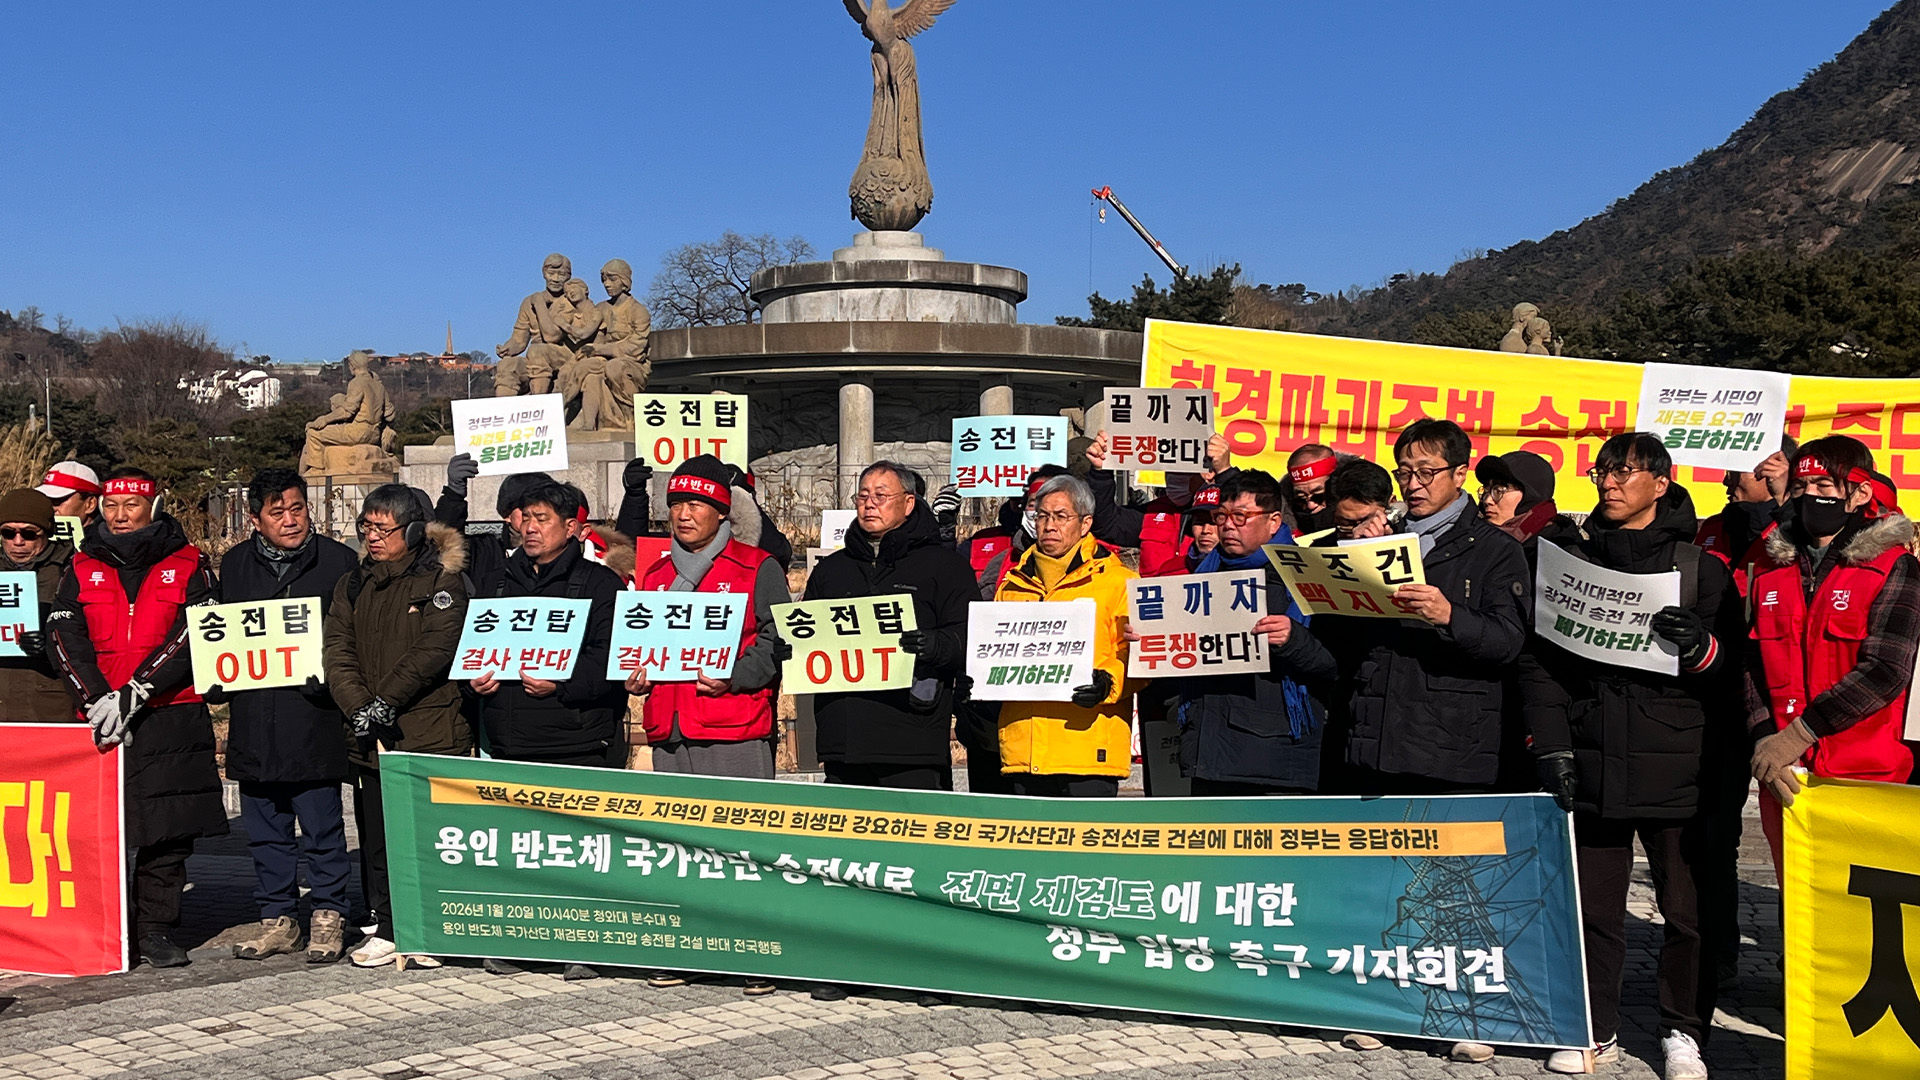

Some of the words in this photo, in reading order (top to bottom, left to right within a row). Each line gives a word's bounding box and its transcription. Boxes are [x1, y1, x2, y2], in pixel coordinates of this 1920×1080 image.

[1659, 388, 1708, 404] 정부는
[1711, 390, 1763, 406] 시민의
[468, 416, 504, 431] 정부는
[508, 409, 545, 424] 시민의
[643, 399, 739, 428] 송전탑
[1654, 410, 1707, 426] 재검토
[1707, 411, 1763, 428] 요구에
[469, 431, 507, 447] 재검토
[509, 425, 549, 442] 요구에
[958, 426, 1056, 452] 송전탑
[1663, 428, 1766, 451] 응답하라!
[479, 439, 554, 464] 응답하라!
[955, 464, 1038, 488] 결사반
[1274, 546, 1415, 585] 무조건
[1560, 573, 1644, 606] 구시대적인
[623, 602, 734, 630] 송전탑
[1544, 585, 1587, 615] 장거리
[1589, 606, 1626, 625] 송전
[1628, 612, 1654, 627] 계
[199, 603, 312, 642] 송전탑
[473, 608, 576, 633] 송전탑
[785, 601, 904, 639] 송전탑
[995, 620, 1068, 637] 구시대적인
[1553, 614, 1654, 653] 폐기하라!
[461, 648, 511, 672] 결사
[519, 647, 571, 671] 반대
[616, 646, 670, 671] 결사
[679, 646, 731, 671] 반대
[976, 642, 1020, 659] 장거리
[1022, 641, 1053, 658] 송전
[1054, 640, 1086, 656] 계획
[1138, 632, 1261, 670] 투쟁한다!
[216, 645, 301, 684] OUT
[806, 646, 897, 684] OUT
[986, 664, 1074, 686] 폐기하라!
[476, 785, 511, 803] 전력
[513, 789, 601, 811] 수요분산은
[603, 797, 645, 817] 뒷전,
[651, 801, 708, 822] 지역의
[711, 805, 786, 828] 일방적인
[790, 811, 848, 833] 희생만
[852, 815, 928, 838] 강요하는
[934, 821, 973, 841] 용인
[978, 823, 1076, 846] 국가산단과
[1081, 827, 1160, 848] 송전선로
[1167, 829, 1227, 850] 건설에
[1233, 829, 1273, 850] 대해
[1280, 829, 1341, 850] 정부는
[1348, 828, 1439, 850] 응답하라!
[434, 826, 499, 867] 용인
[511, 829, 611, 873] 반도체
[939, 870, 1026, 913] 전면
[1029, 875, 1202, 924] 재검토에
[1215, 882, 1298, 927] 대한
[441, 902, 484, 917] 2026년
[487, 903, 504, 918] 1월
[506, 905, 535, 919] 20일
[537, 906, 591, 922] 10시40분
[593, 909, 629, 924] 청와대
[631, 911, 667, 927] 분수대
[668, 914, 682, 928] 앞
[442, 922, 466, 936] 용인
[468, 923, 502, 938] 반도체
[505, 925, 551, 941] 국가산단
[553, 928, 600, 943] 재검토와
[602, 930, 637, 946] 초고압
[640, 932, 676, 948] 송전탑
[679, 935, 703, 950] 건설
[706, 937, 731, 952] 반대
[733, 938, 783, 956] 전국행동
[1046, 923, 1127, 964] 정부
[1135, 933, 1215, 972] 입장
[1229, 940, 1313, 980] 촉구
[1326, 944, 1510, 994] 기자회견
